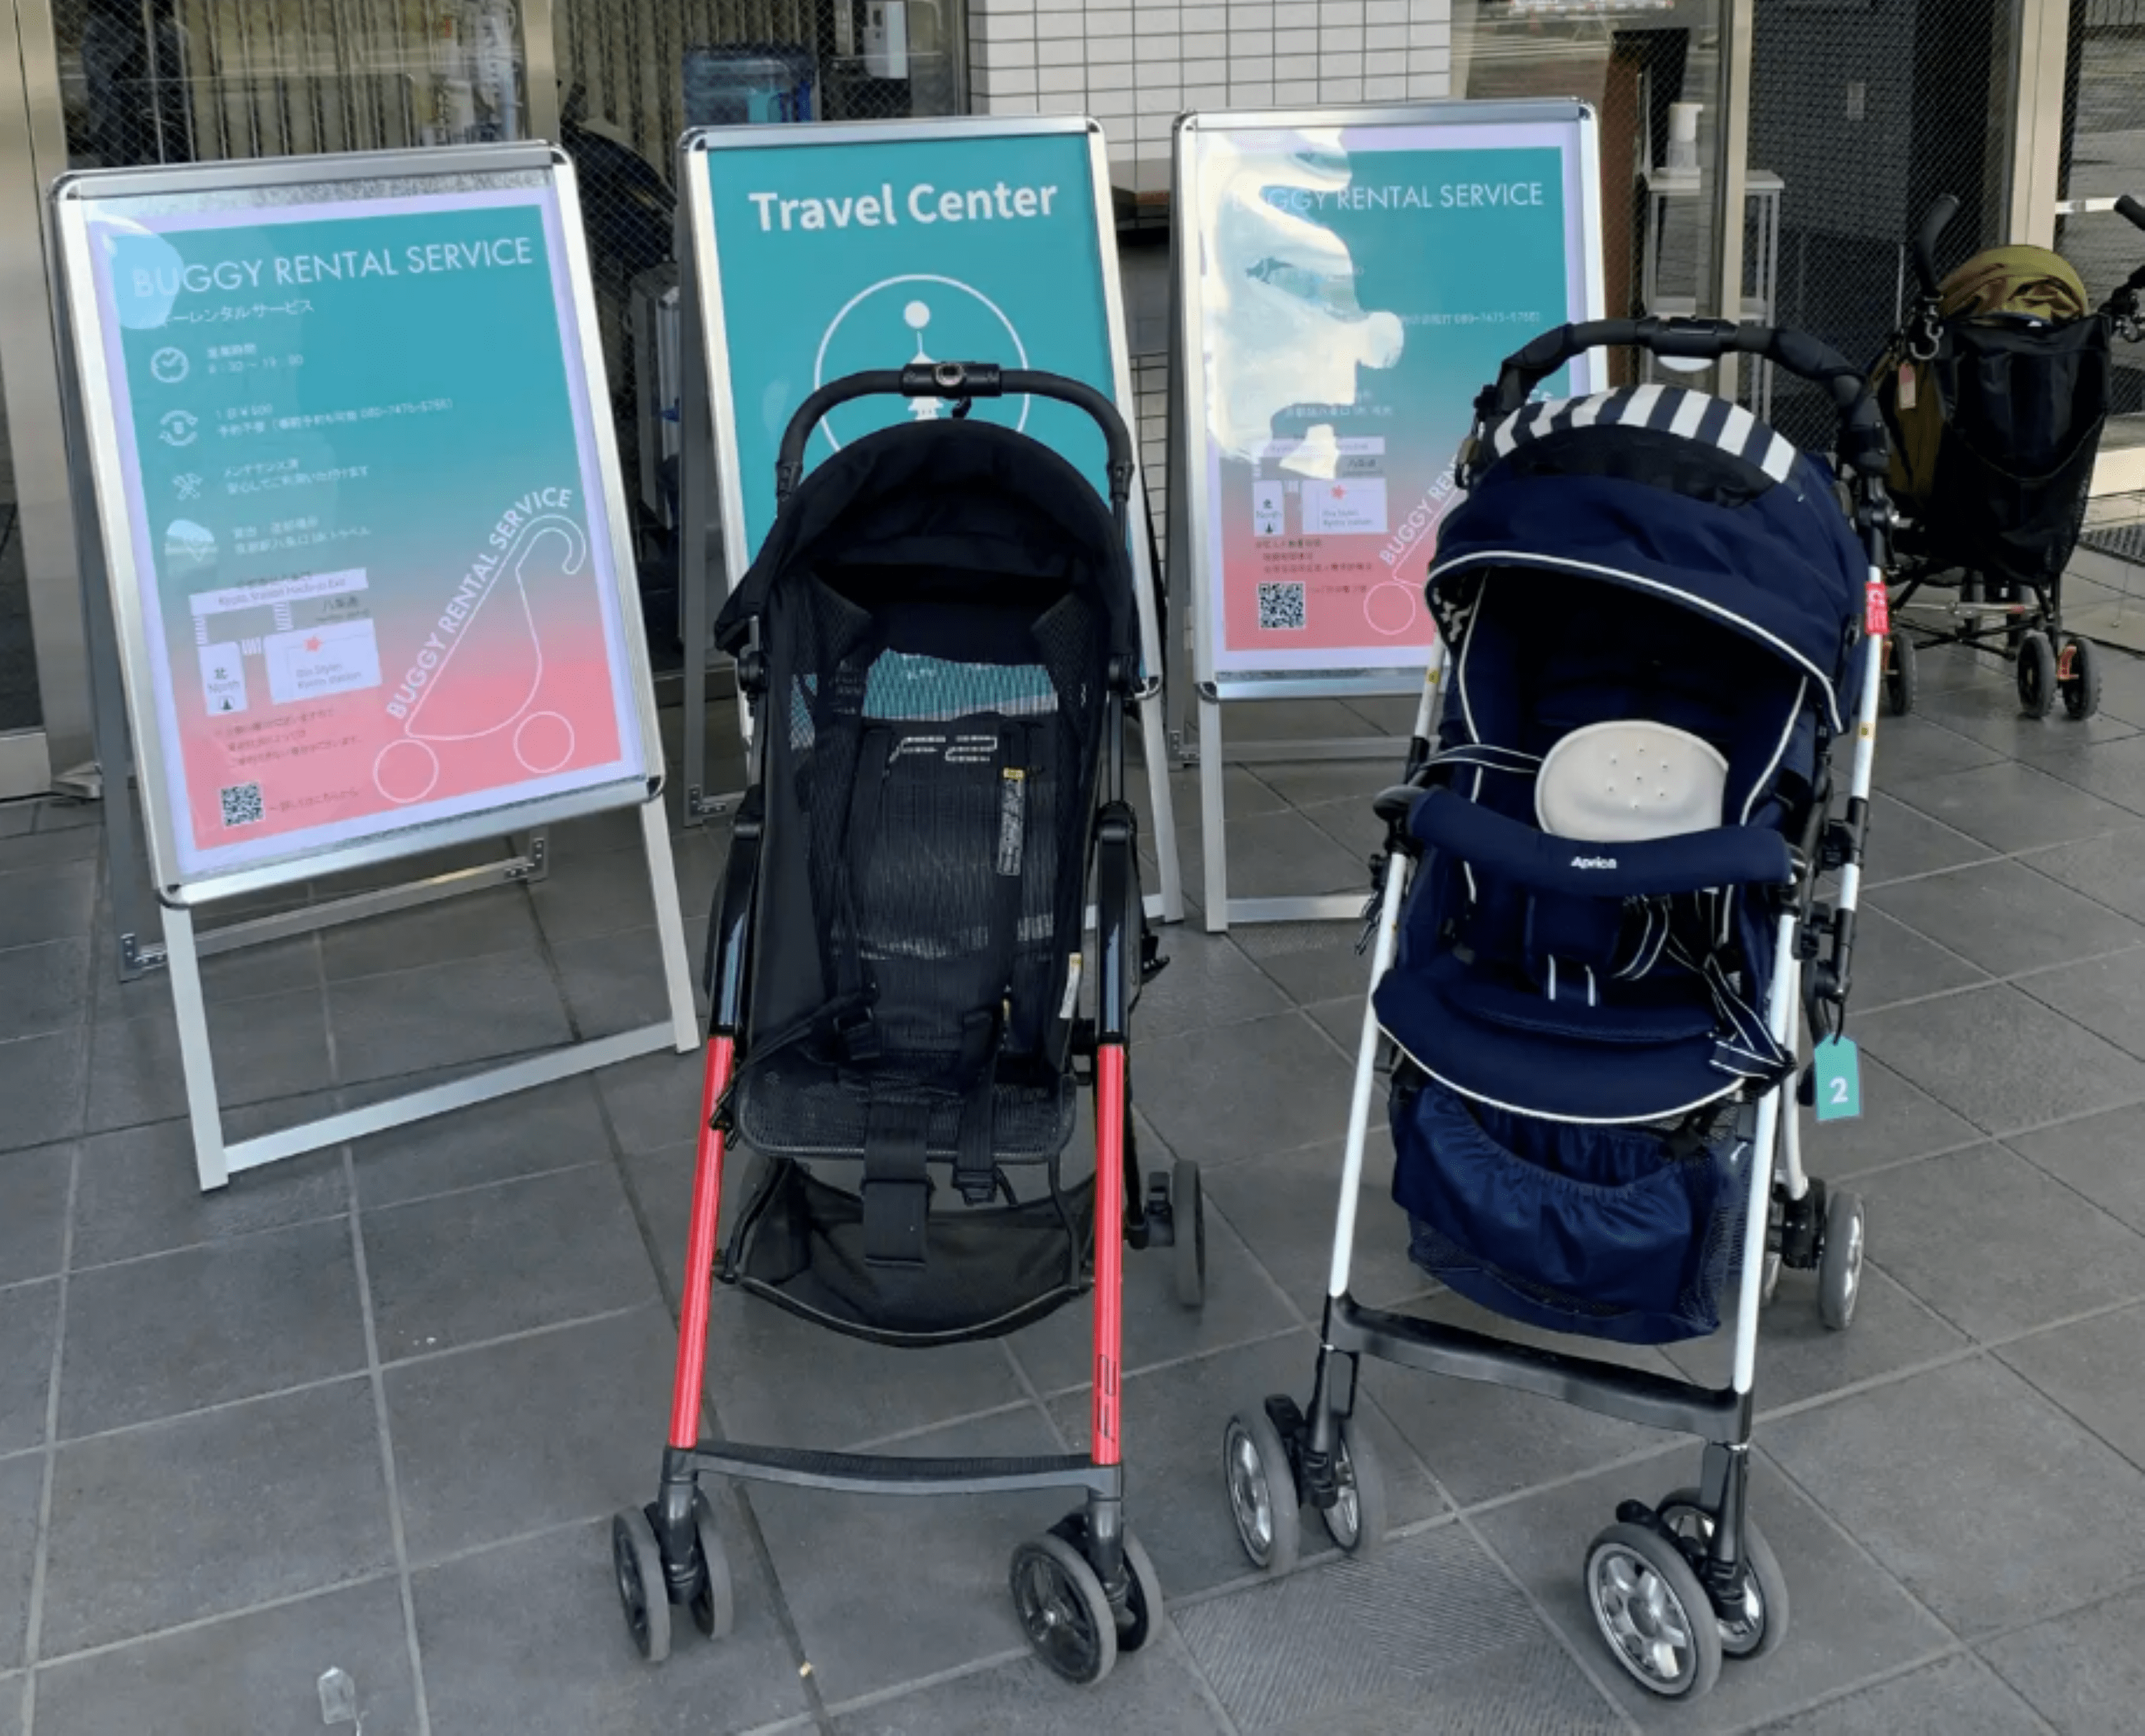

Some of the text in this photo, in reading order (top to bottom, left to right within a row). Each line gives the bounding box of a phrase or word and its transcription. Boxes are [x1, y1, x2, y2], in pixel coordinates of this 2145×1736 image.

[749, 181, 1059, 231] Travel Center
[1246, 182, 1543, 212] GGY RENTAL SERVICE
[132, 237, 533, 297] BUGGY RENTAL SERVICE
[166, 299, 315, 325] ーレンタルサービス
[1379, 498, 1433, 566] BUGGY
[386, 486, 573, 720] BUGGY RENTAL SERVICE
[1571, 856, 1617, 869] Aprica
[1828, 1075, 1849, 1105] 2
